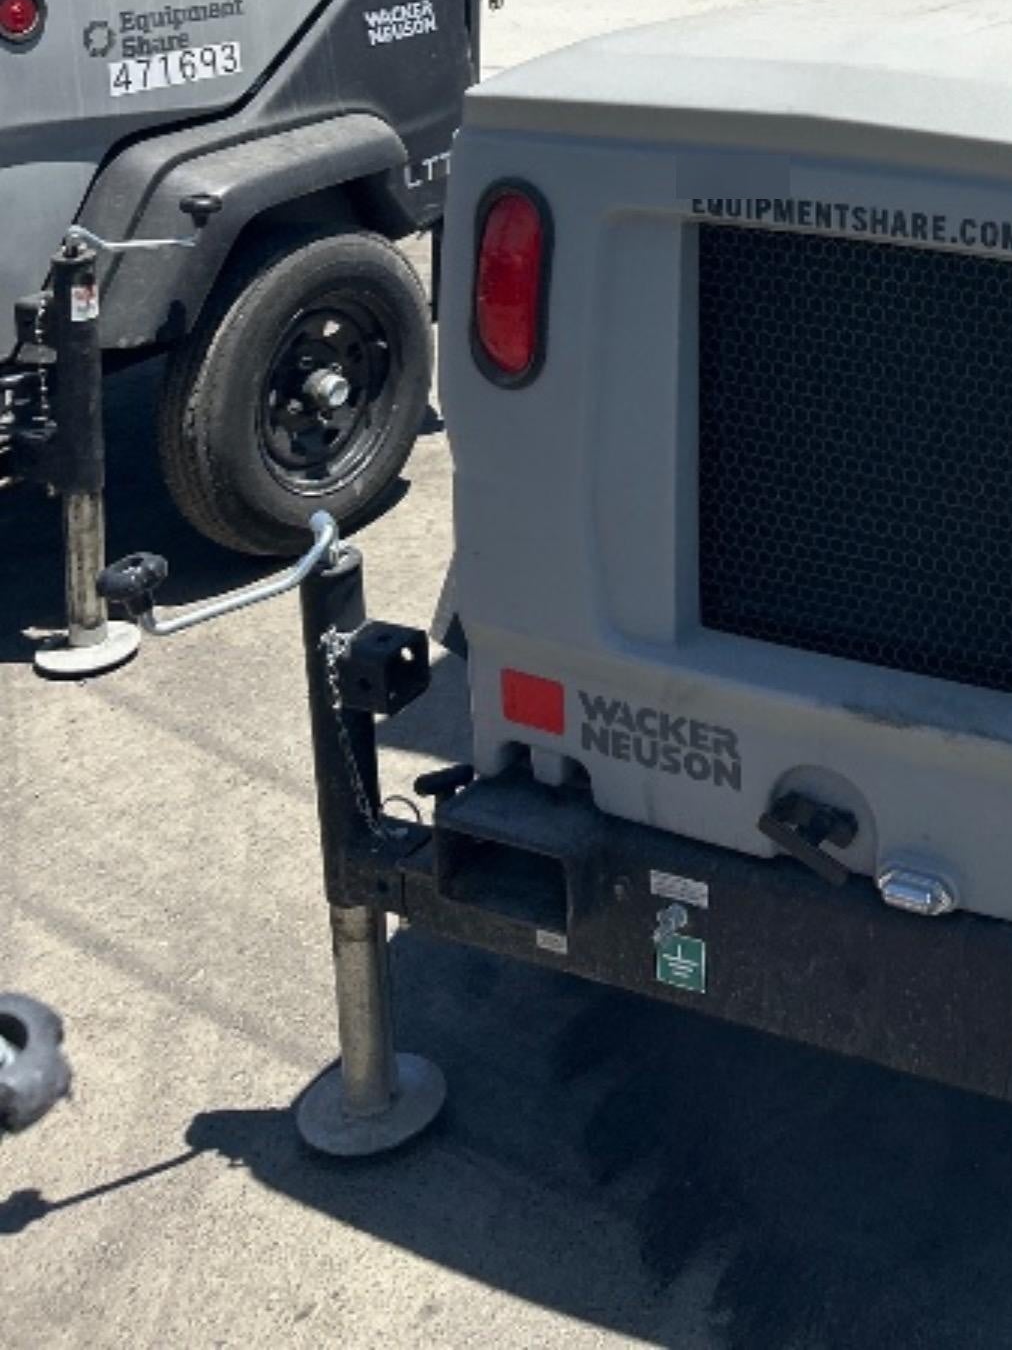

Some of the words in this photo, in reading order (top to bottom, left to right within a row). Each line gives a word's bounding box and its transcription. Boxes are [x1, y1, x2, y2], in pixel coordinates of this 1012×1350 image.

[363, 0, 434, 28] WACKER
[367, 12, 438, 46] NEUSON
[121, 32, 190, 58] Share
[112, 43, 238, 92] 471693
[578, 690, 741, 760] WACKER
[580, 722, 742, 792] NEUSON
